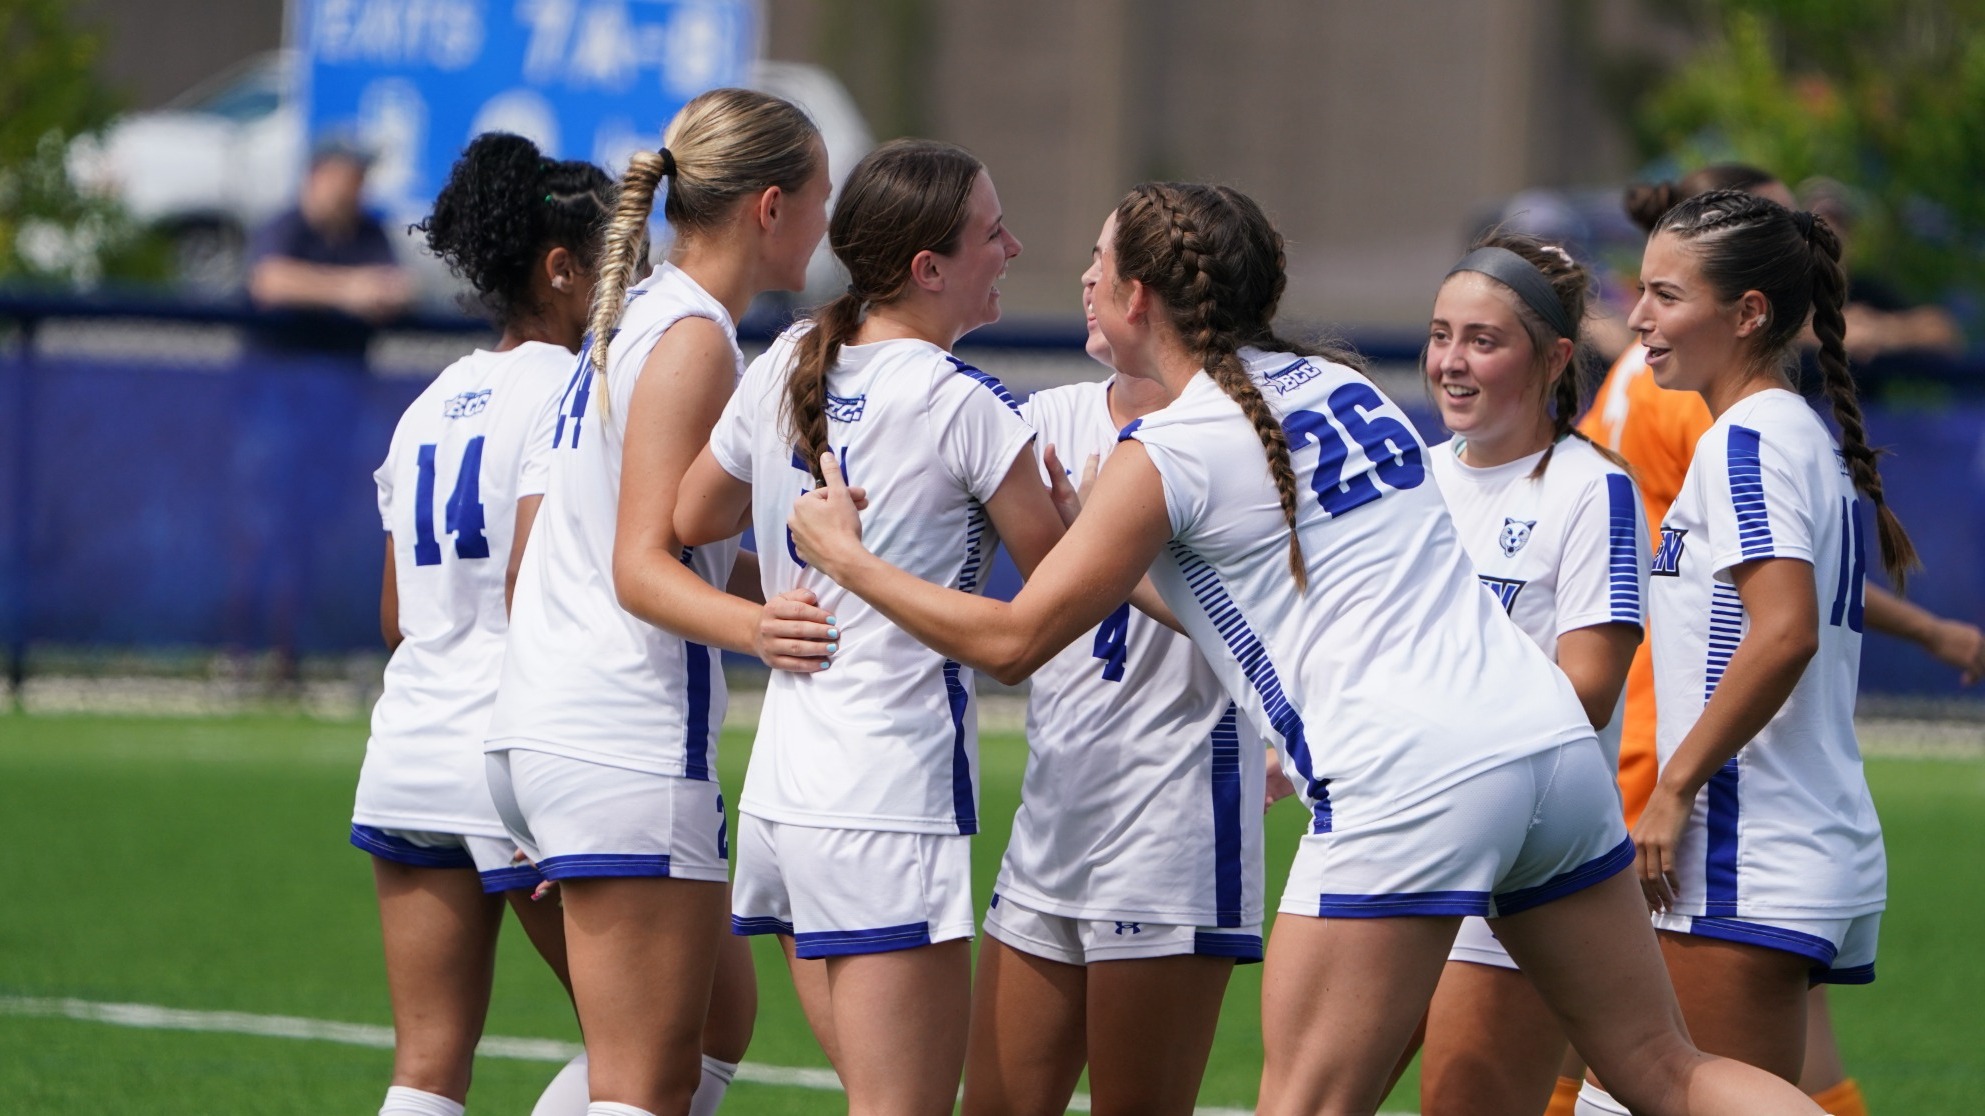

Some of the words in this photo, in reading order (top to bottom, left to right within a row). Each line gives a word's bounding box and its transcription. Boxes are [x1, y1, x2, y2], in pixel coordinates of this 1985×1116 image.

[414, 435, 490, 566] 14
[1281, 382, 1425, 519] 26
[1092, 602, 1130, 683] 4
